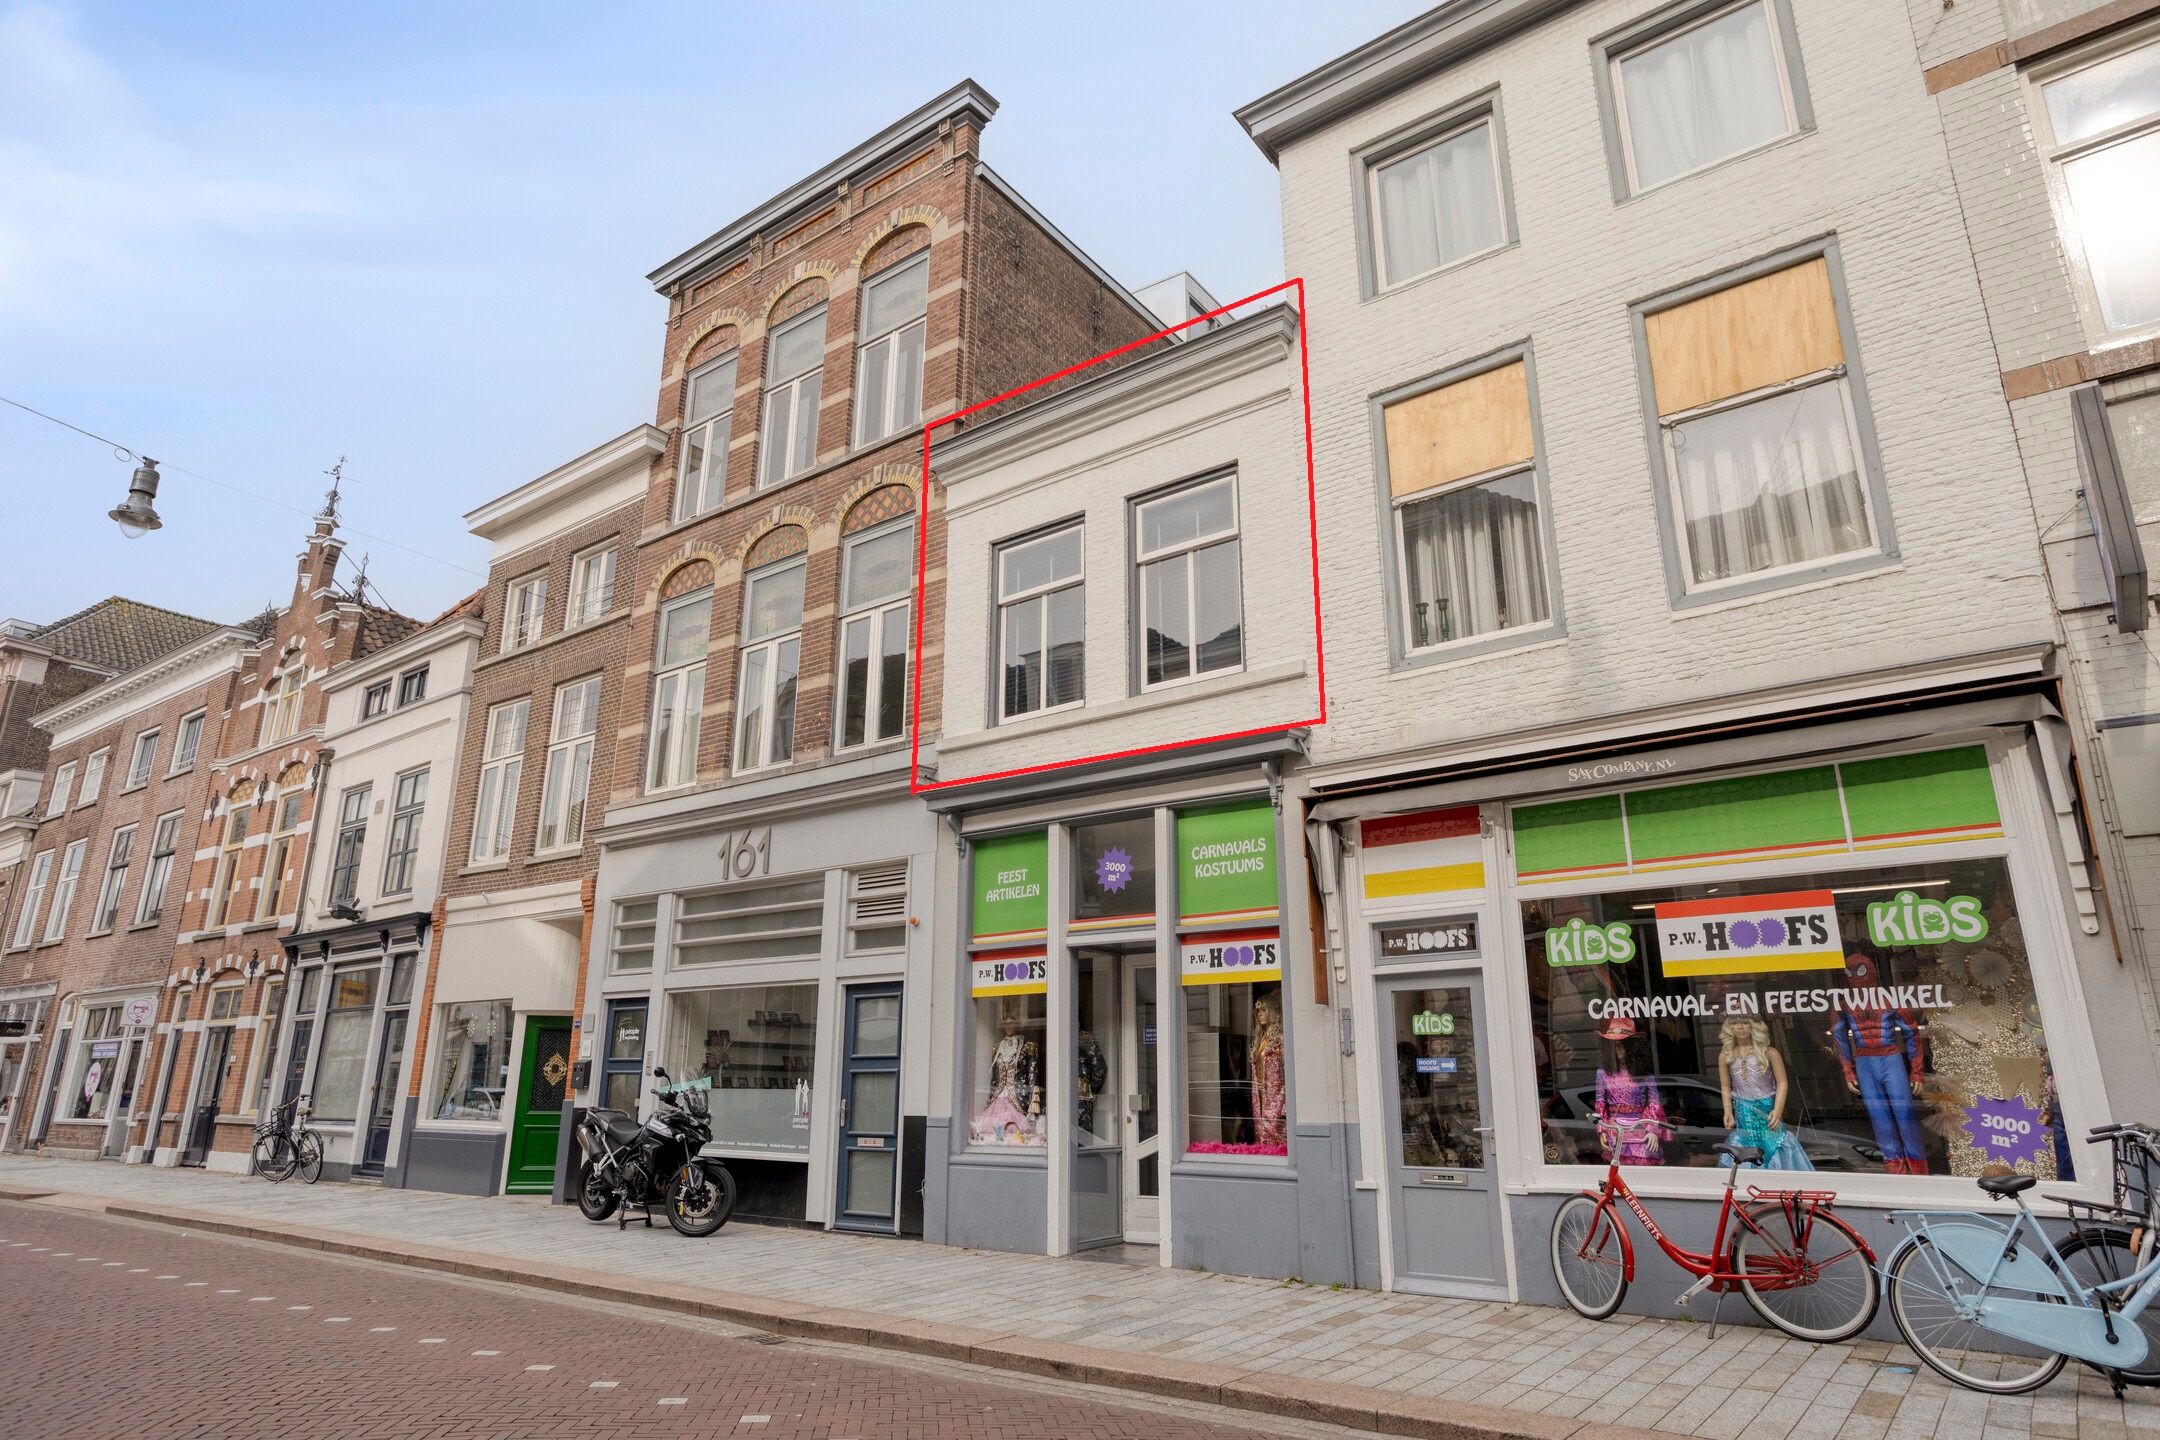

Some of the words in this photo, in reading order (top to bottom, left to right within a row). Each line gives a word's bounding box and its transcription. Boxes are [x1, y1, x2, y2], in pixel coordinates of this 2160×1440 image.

[717, 824, 772, 880] 161
[1191, 837, 1267, 860] CARNAVALS
[998, 869, 1028, 885] FEEST
[1104, 861, 1126, 873] 3000
[1195, 857, 1265, 879] KOSTUUMS
[986, 884, 1040, 903] ARTIKELEN
[1388, 938, 1406, 948] P.W.
[1405, 928, 1468, 951] HOOFS
[1668, 931, 1702, 947] P.W.
[1702, 914, 1828, 951] HOOFS
[1190, 955, 1208, 964] P.W.
[1209, 943, 1276, 968] HOOFS
[979, 970, 993, 979] P.W.
[994, 960, 1046, 982] HOOFS
[1588, 994, 1719, 1020] CARNAVAL-
[1725, 992, 1759, 1015] EN
[1766, 984, 1953, 1014] FEESTWINKEL
[1981, 1113, 2031, 1135] 3000
